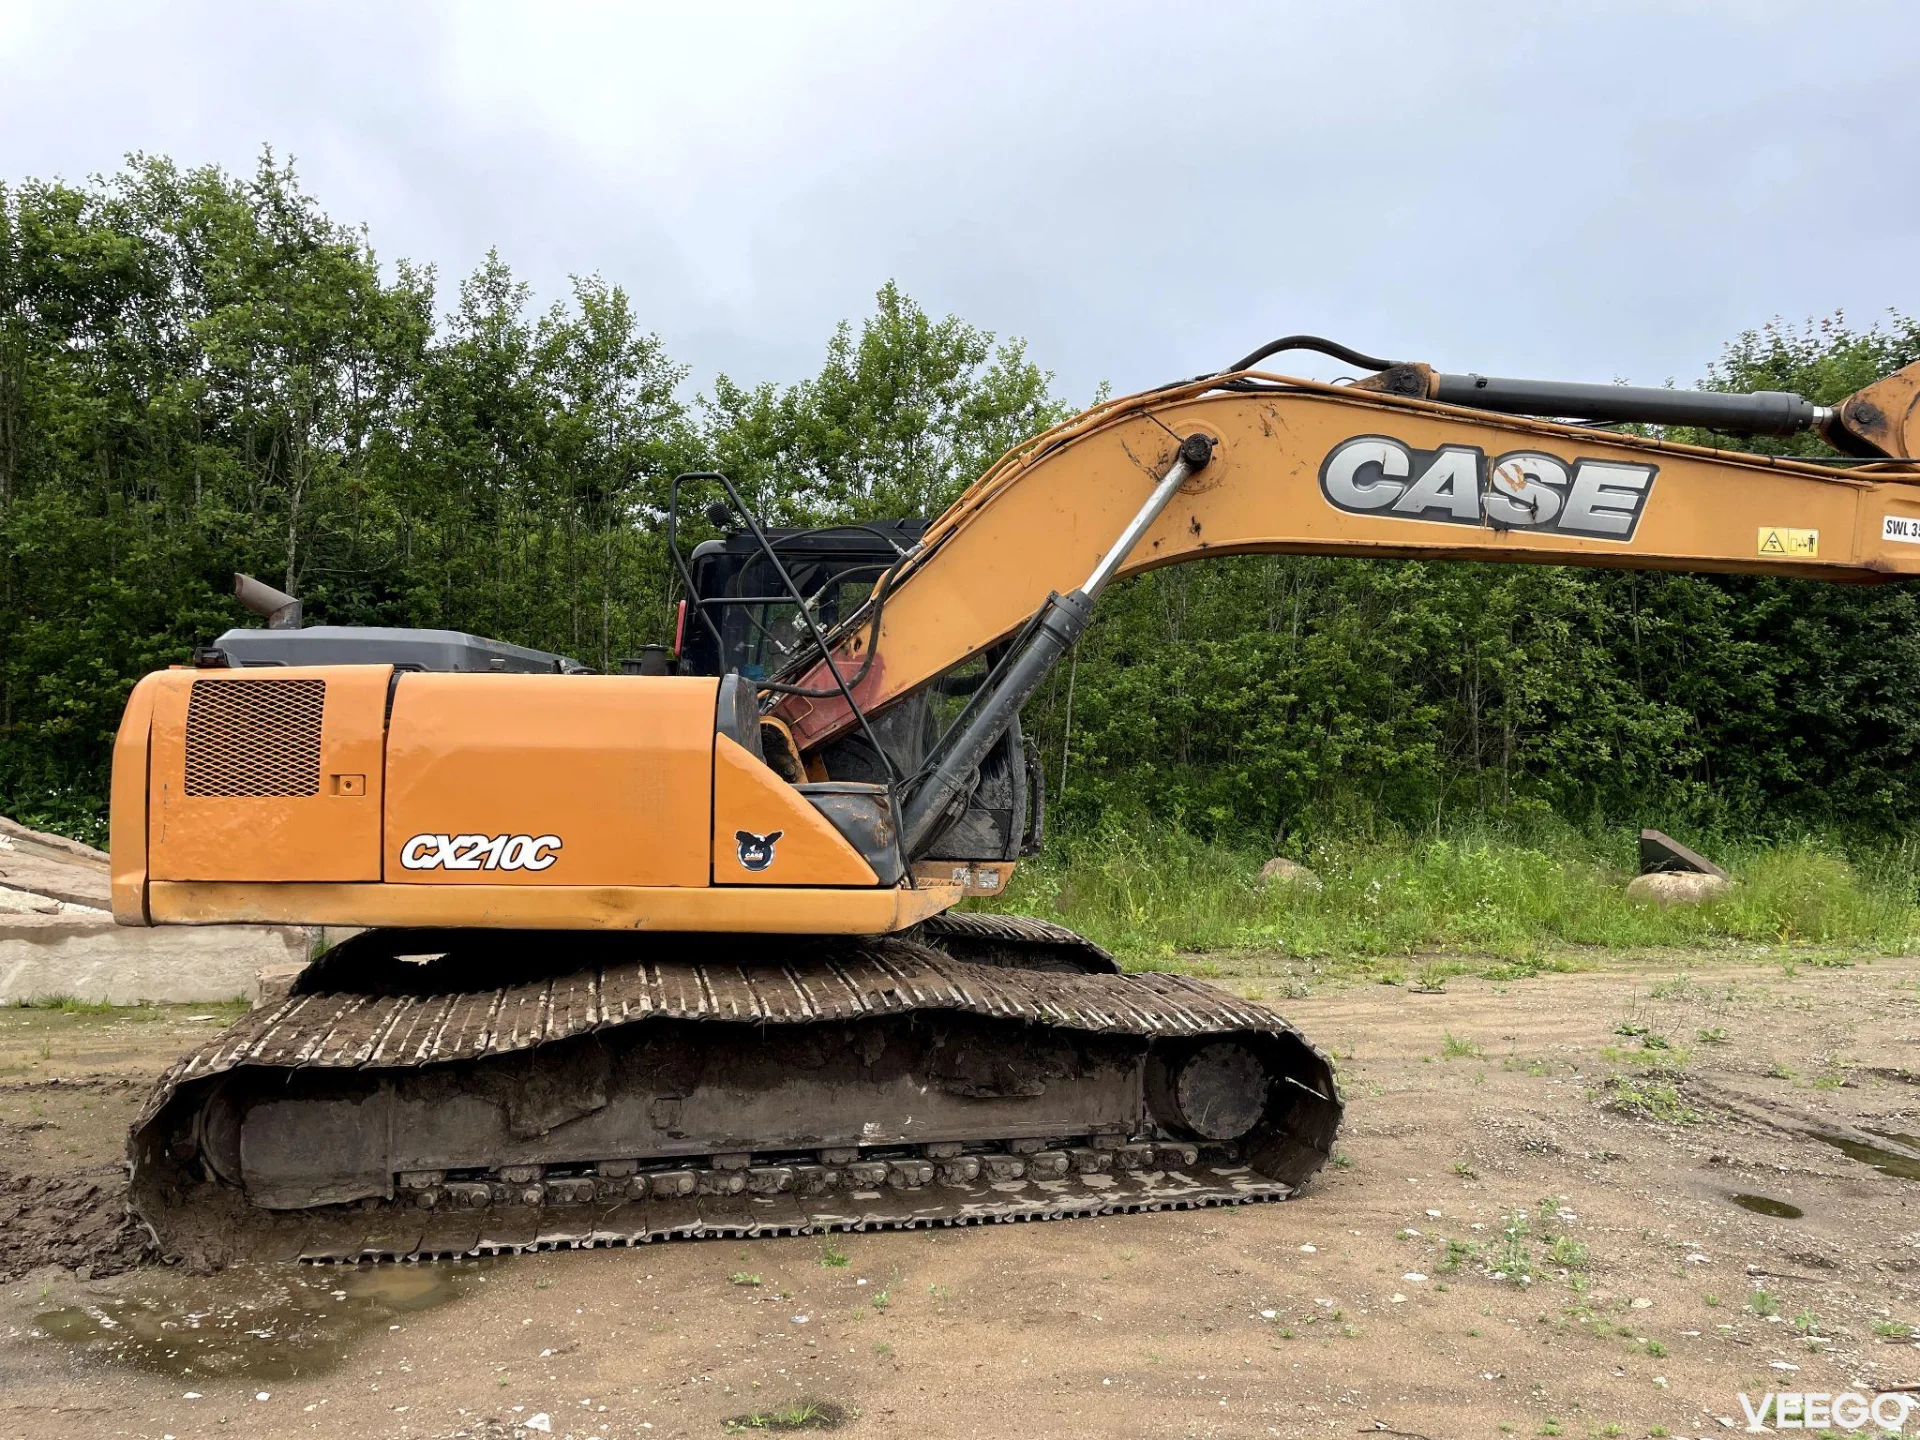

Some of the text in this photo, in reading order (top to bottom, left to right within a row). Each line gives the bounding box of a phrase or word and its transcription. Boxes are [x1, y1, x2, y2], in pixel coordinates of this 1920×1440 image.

[1324, 441, 1652, 536] CASE
[1886, 519, 1908, 536] SWL
[401, 833, 563, 871] CX210C
